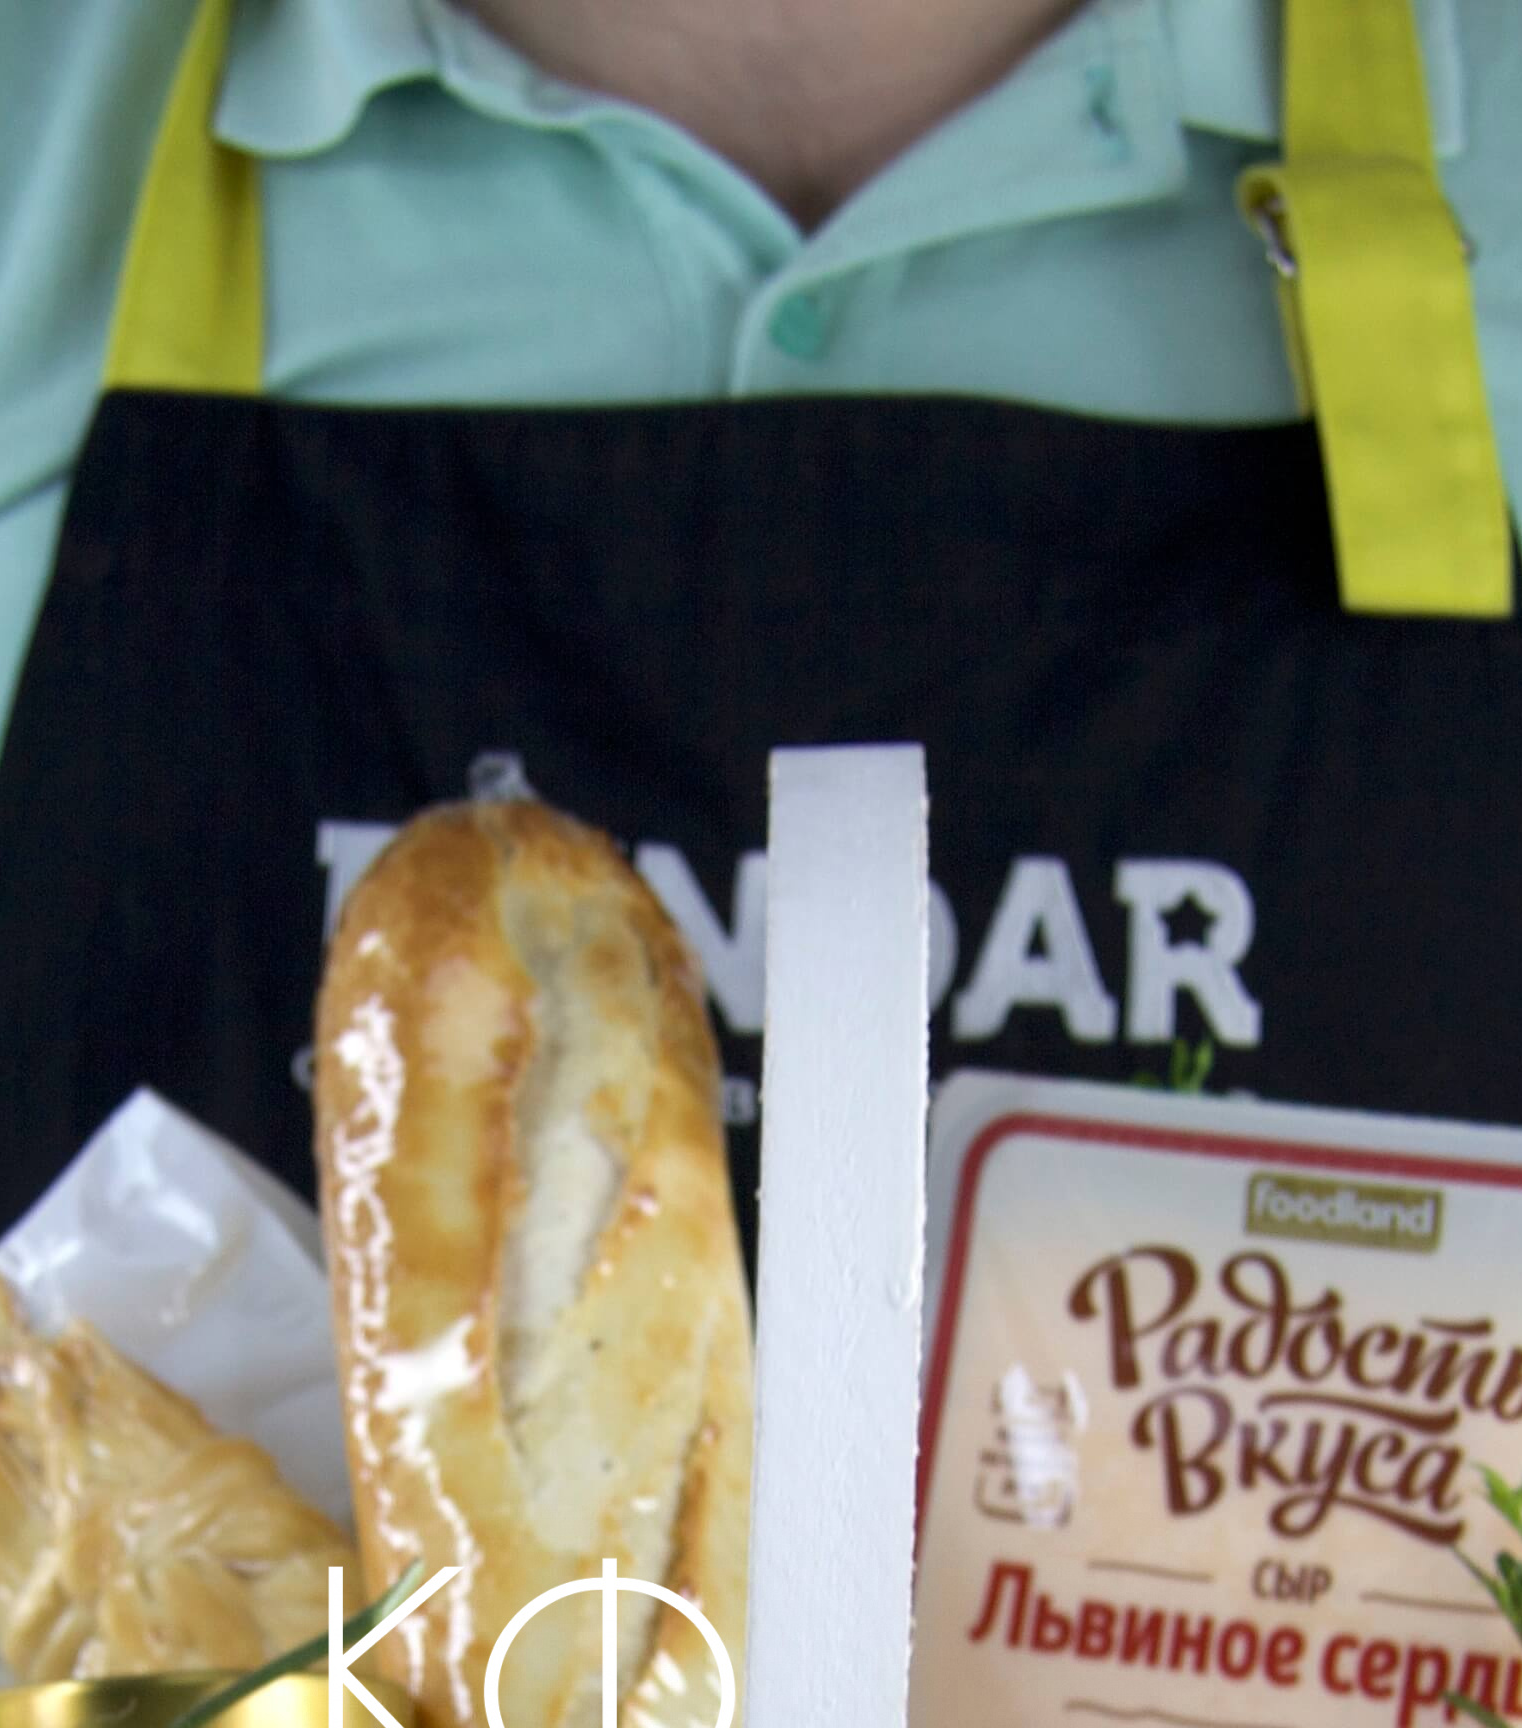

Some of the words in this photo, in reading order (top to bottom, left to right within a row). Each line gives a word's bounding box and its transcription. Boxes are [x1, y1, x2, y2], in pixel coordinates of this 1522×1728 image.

[1254, 1177, 1435, 1234] foodland
[1130, 1386, 1465, 1547] Вкуса
[970, 1562, 1304, 1686] Львиное
